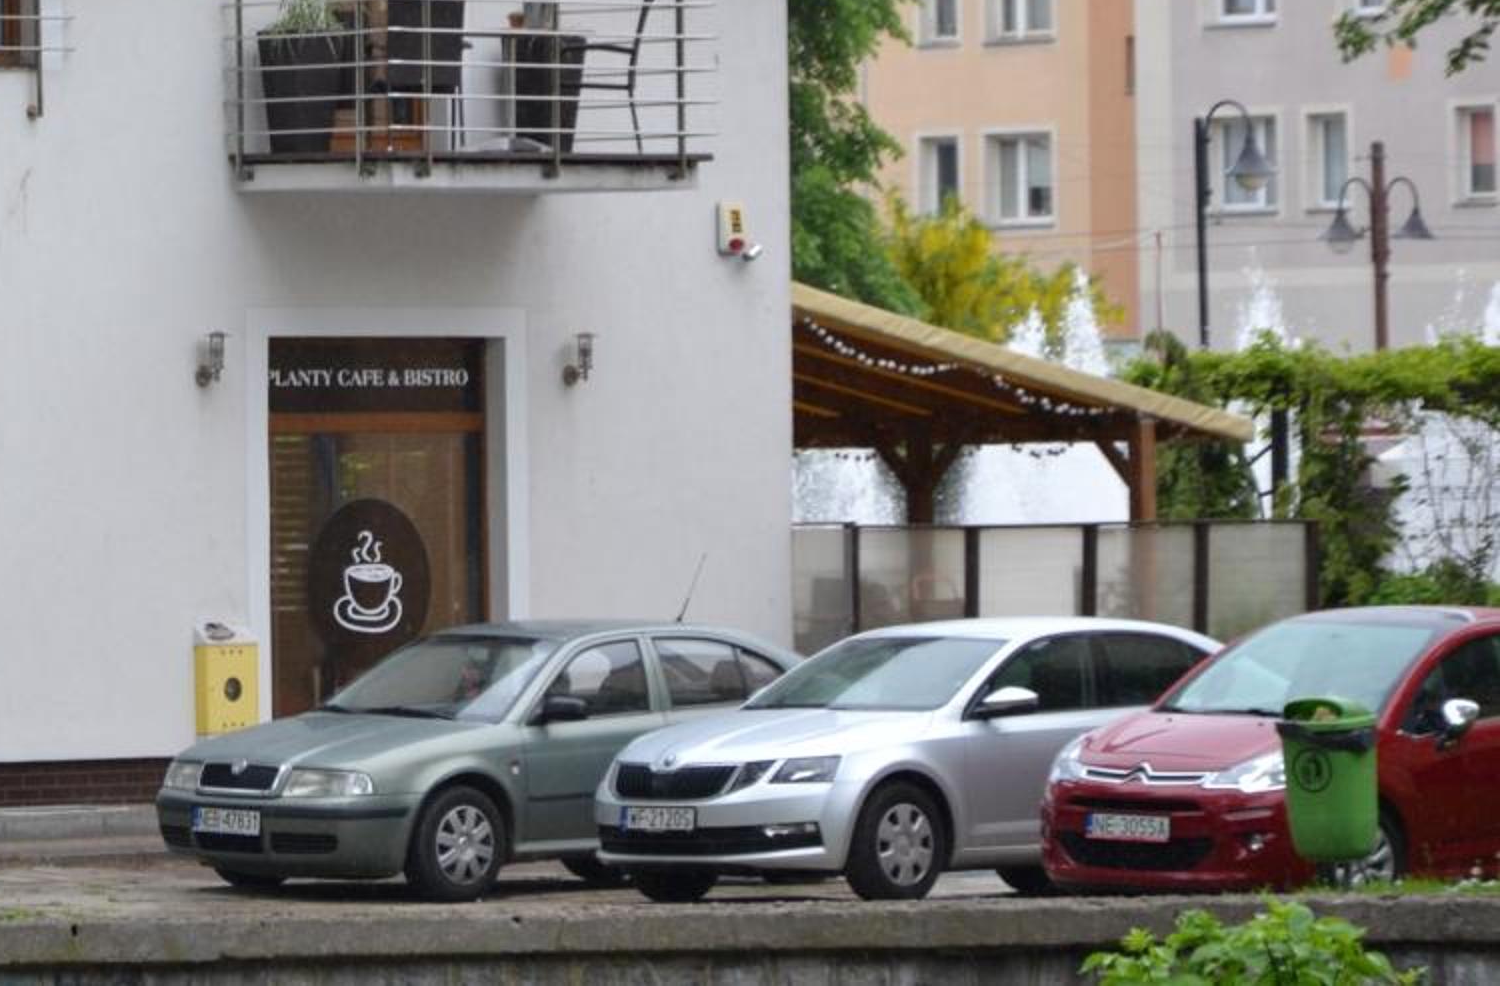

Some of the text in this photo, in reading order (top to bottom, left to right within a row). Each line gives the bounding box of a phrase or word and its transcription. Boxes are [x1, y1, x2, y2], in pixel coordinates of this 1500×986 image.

[337, 369, 384, 387] CAFE
[387, 370, 400, 387] &
[403, 369, 469, 387] BISTRO
